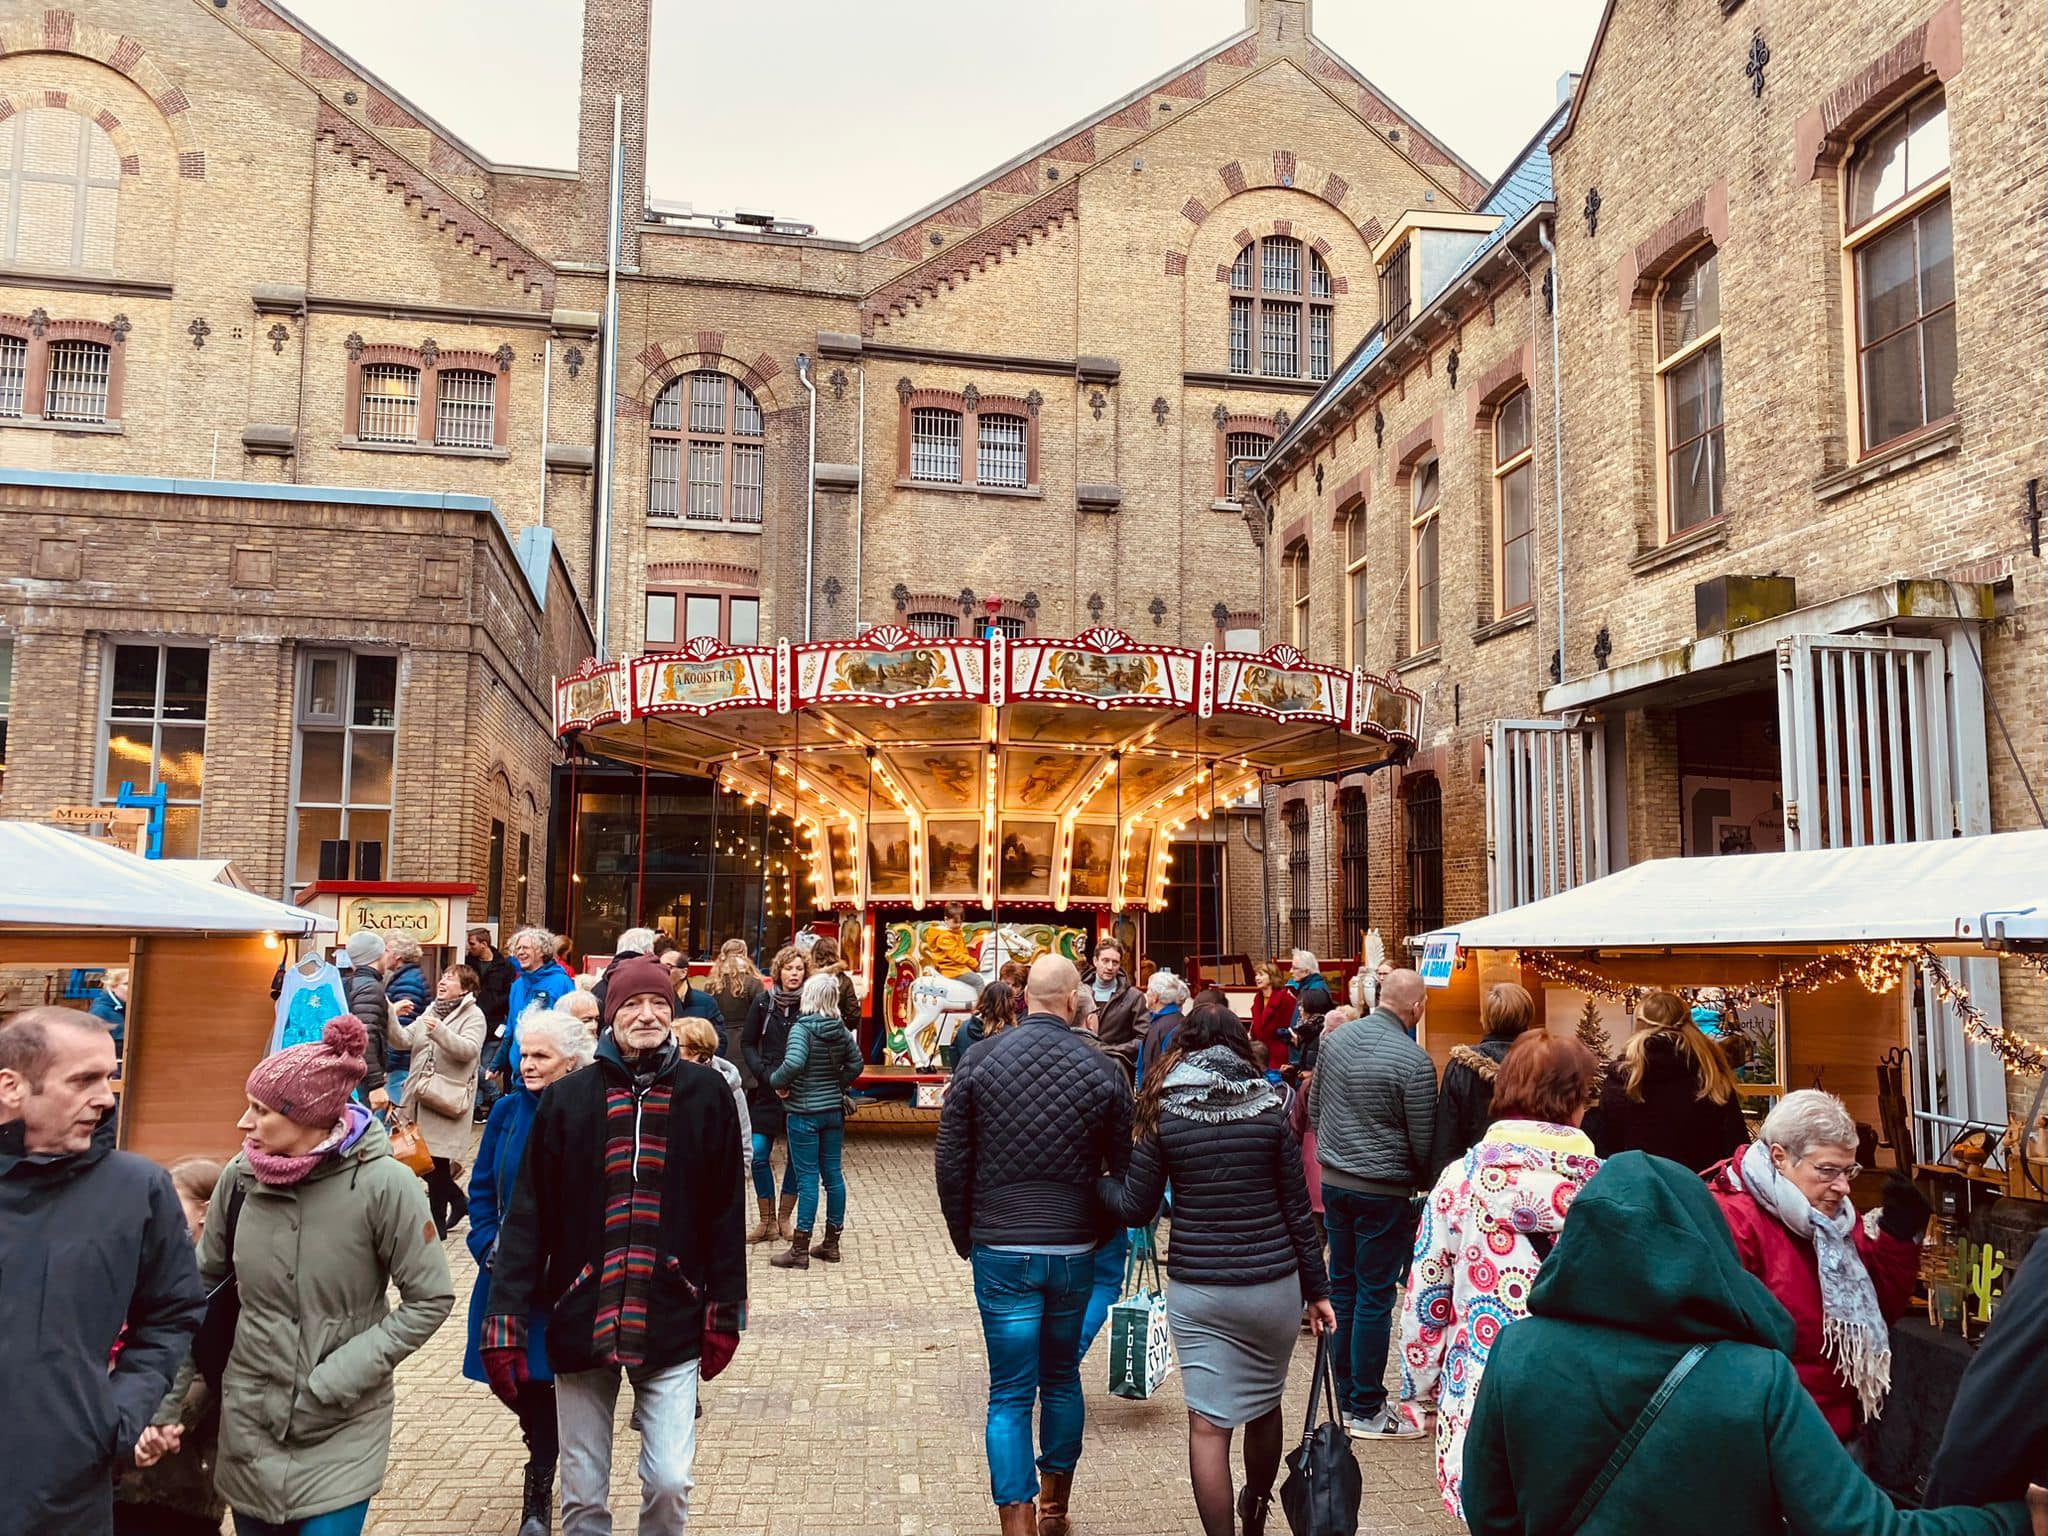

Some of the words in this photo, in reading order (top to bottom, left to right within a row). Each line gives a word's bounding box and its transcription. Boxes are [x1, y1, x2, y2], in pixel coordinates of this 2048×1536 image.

[684, 670, 733, 685] KOOISTRA
[56, 809, 119, 820] Muziek
[358, 906, 428, 930] Kassa
[1125, 1321, 1135, 1383] DEPOT
